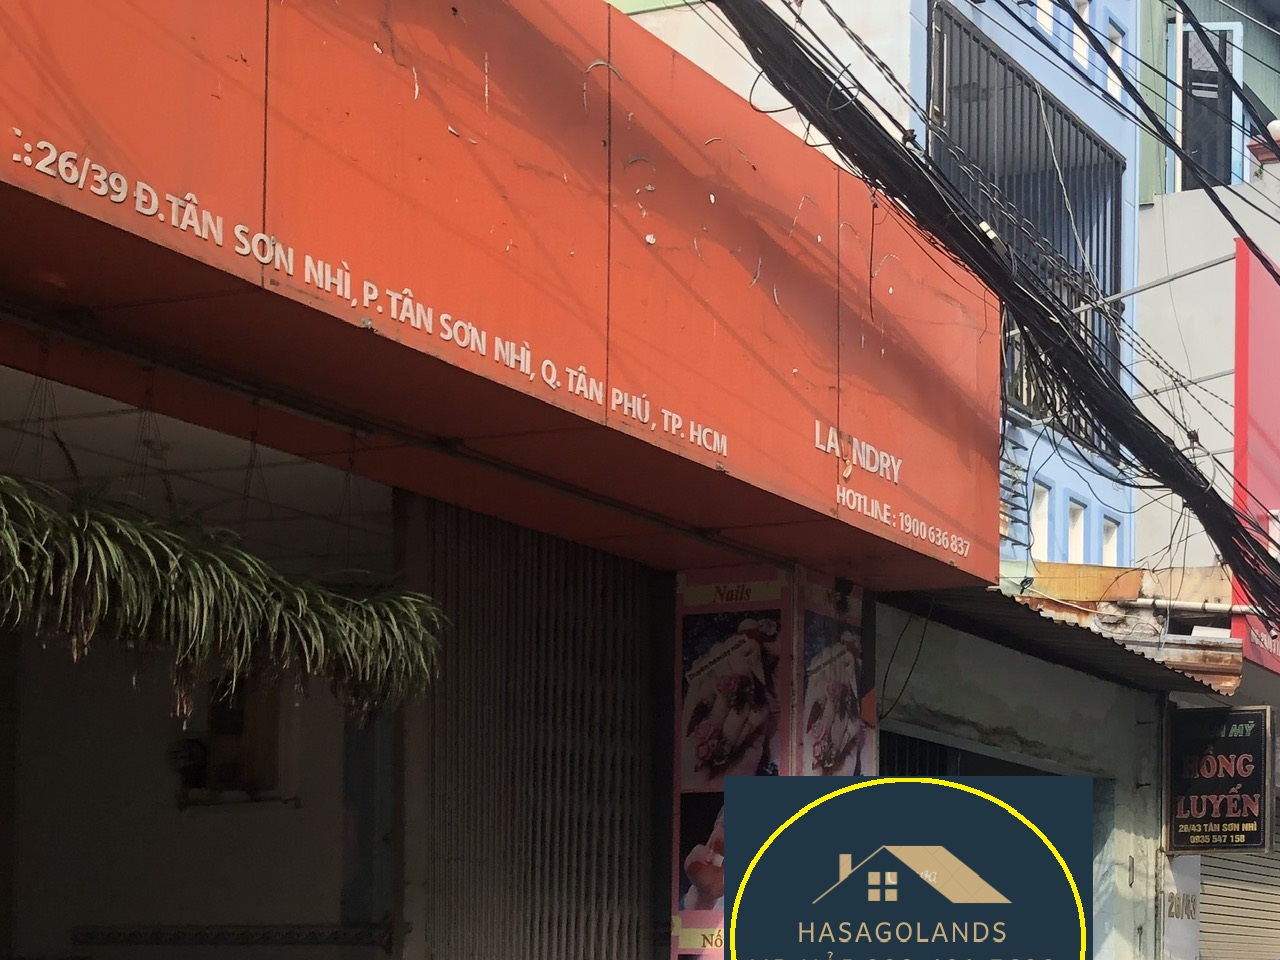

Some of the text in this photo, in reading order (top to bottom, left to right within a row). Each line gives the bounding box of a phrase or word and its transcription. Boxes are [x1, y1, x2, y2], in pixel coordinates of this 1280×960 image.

[234, 224, 293, 276] SƠN
[440, 313, 487, 356] SƠN
[689, 420, 728, 457] HCM
[815, 419, 902, 485] LANDRY
[899, 512, 927, 541] 1900
[928, 526, 949, 550] 636
[950, 534, 970, 558] 837
[713, 586, 752, 602] Nails
[1228, 721, 1255, 737] MỸ
[1204, 821, 1220, 832] TÂN
[1222, 821, 1240, 832] SƠN
[1230, 834, 1246, 844] 158
